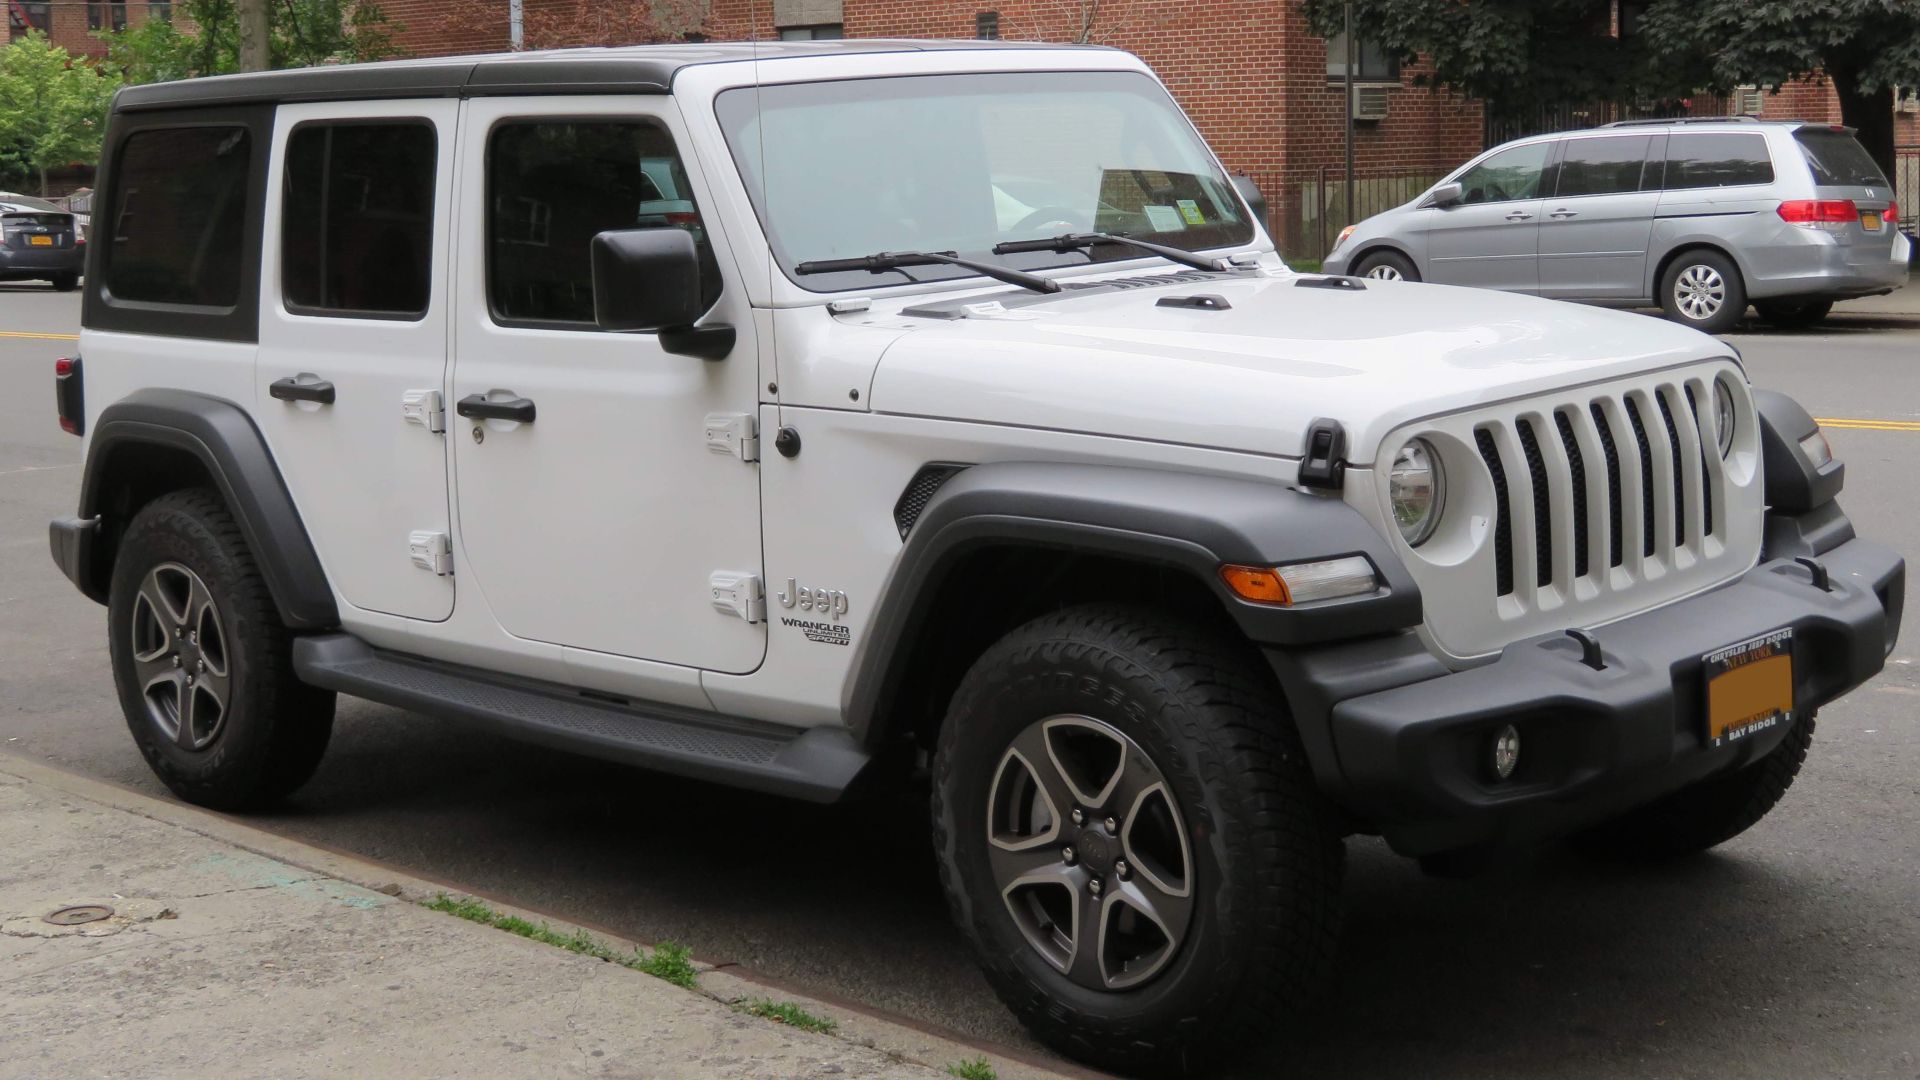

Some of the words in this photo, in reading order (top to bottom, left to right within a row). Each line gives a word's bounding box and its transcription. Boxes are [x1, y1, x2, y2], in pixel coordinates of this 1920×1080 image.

[777, 577, 848, 621] Jeep
[780, 617, 849, 633] WRANGLER
[803, 628, 850, 639] UNLIMITED
[1711, 646, 1746, 663] CHRYSLER
[1748, 640, 1764, 650] JEEP
[1766, 631, 1793, 644] DODGE
[1729, 728, 1746, 741] BAY
[1748, 717, 1776, 733] RIDGE
